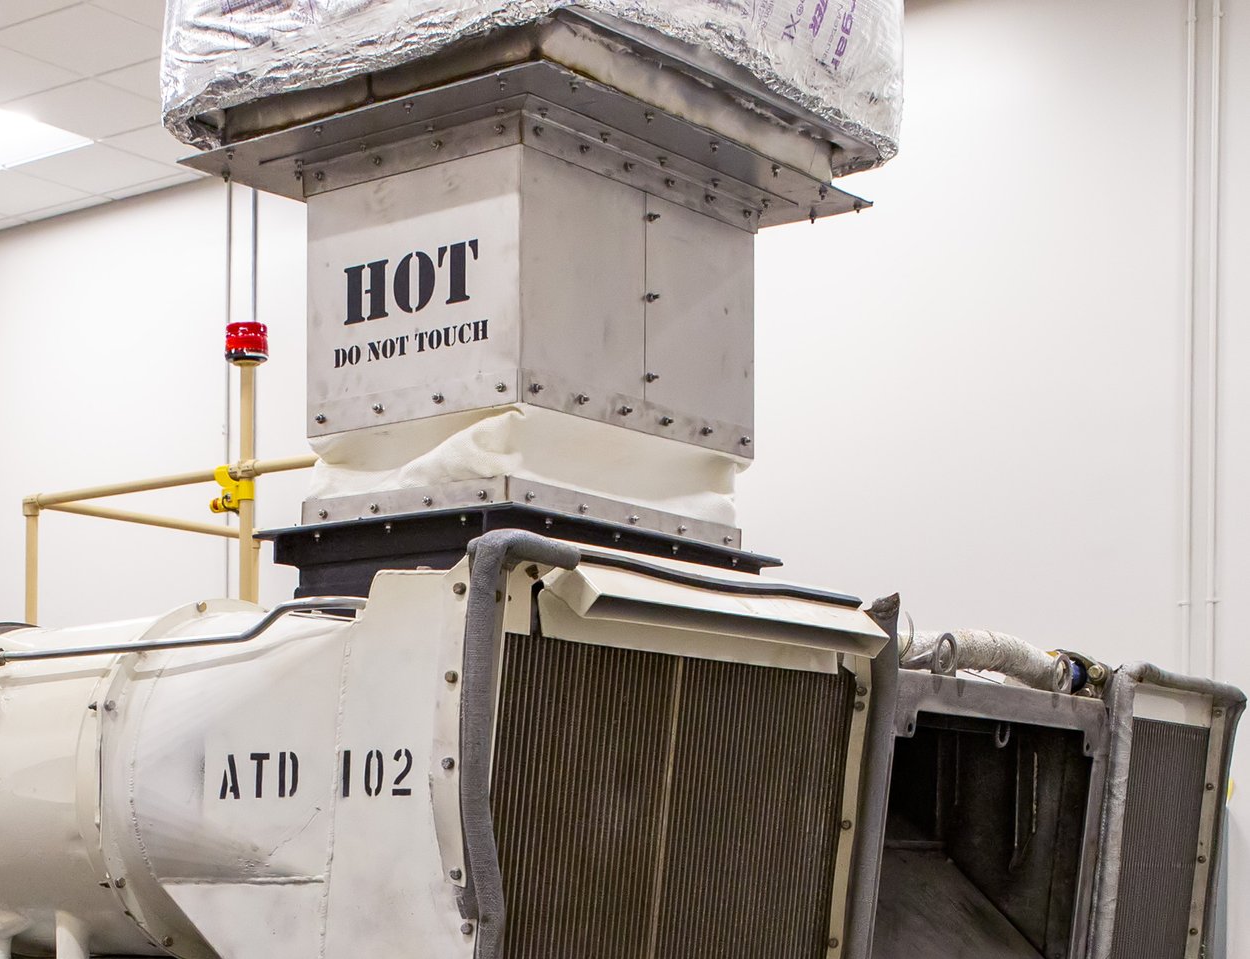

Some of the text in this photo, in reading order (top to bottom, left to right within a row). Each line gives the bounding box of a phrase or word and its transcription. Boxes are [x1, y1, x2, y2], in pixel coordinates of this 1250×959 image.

[343, 238, 479, 326] HOT
[333, 319, 489, 369] DO NOT TOUCH
[219, 748, 414, 800] ATD 102
